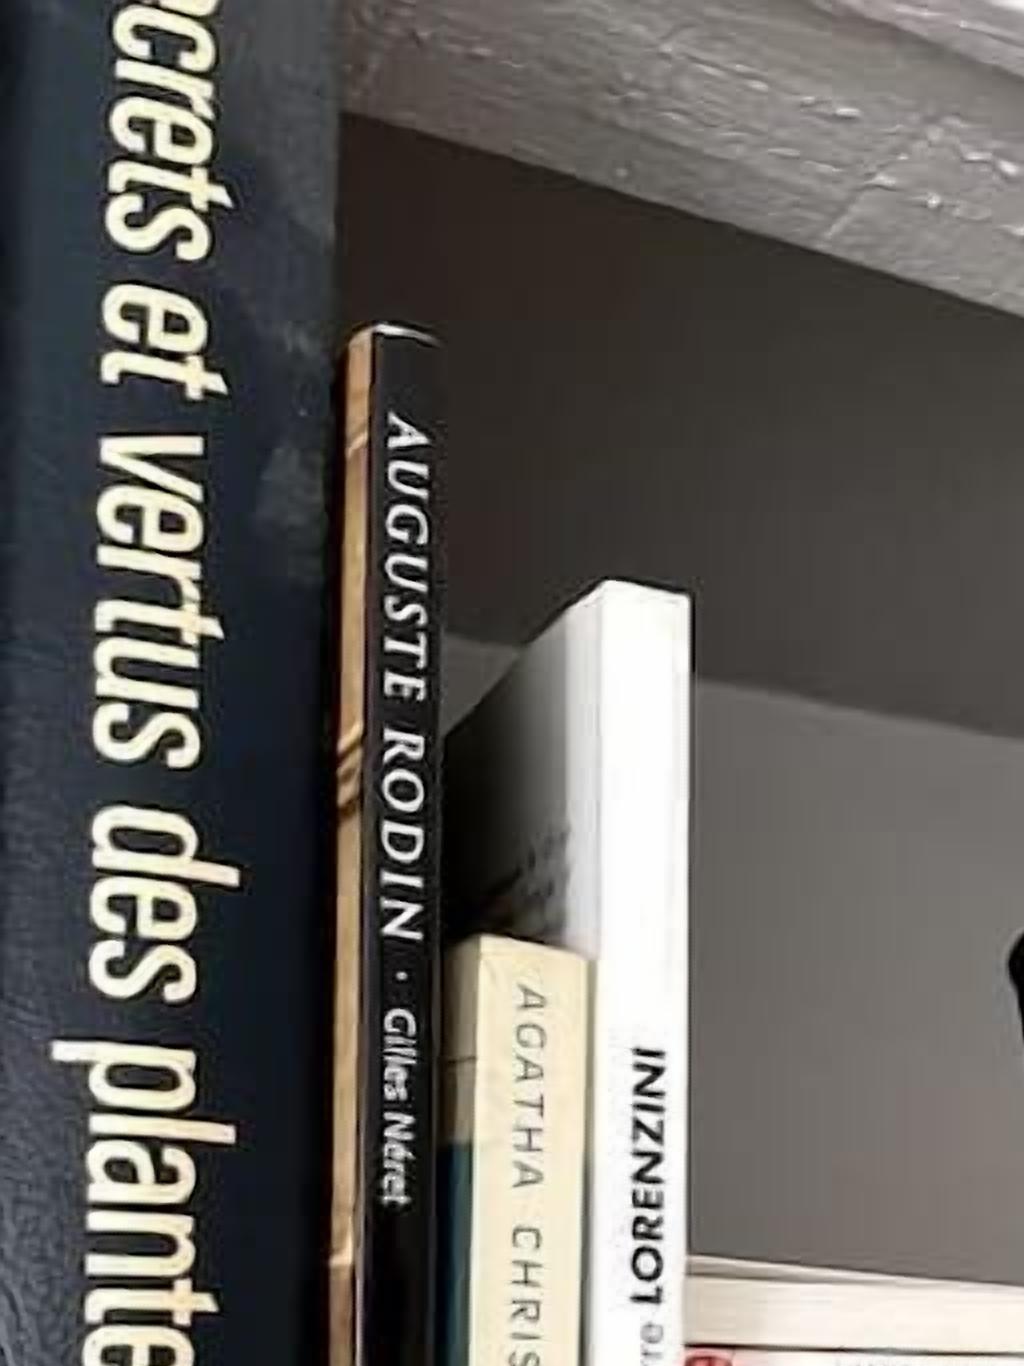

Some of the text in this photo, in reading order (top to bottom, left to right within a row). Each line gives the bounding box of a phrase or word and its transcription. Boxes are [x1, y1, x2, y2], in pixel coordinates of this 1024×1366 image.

[103, 0, 234, 262] crets
[101, 283, 229, 399] et
[92, 434, 225, 771] vertus
[383, 413, 430, 703] AUGUSTE
[90, 804, 241, 1002] des
[378, 728, 426, 941] RODIN
[381, 1007, 418, 1102] Gilles
[511, 984, 547, 1189] AGATHA
[629, 1045, 668, 1306] LORENZINI
